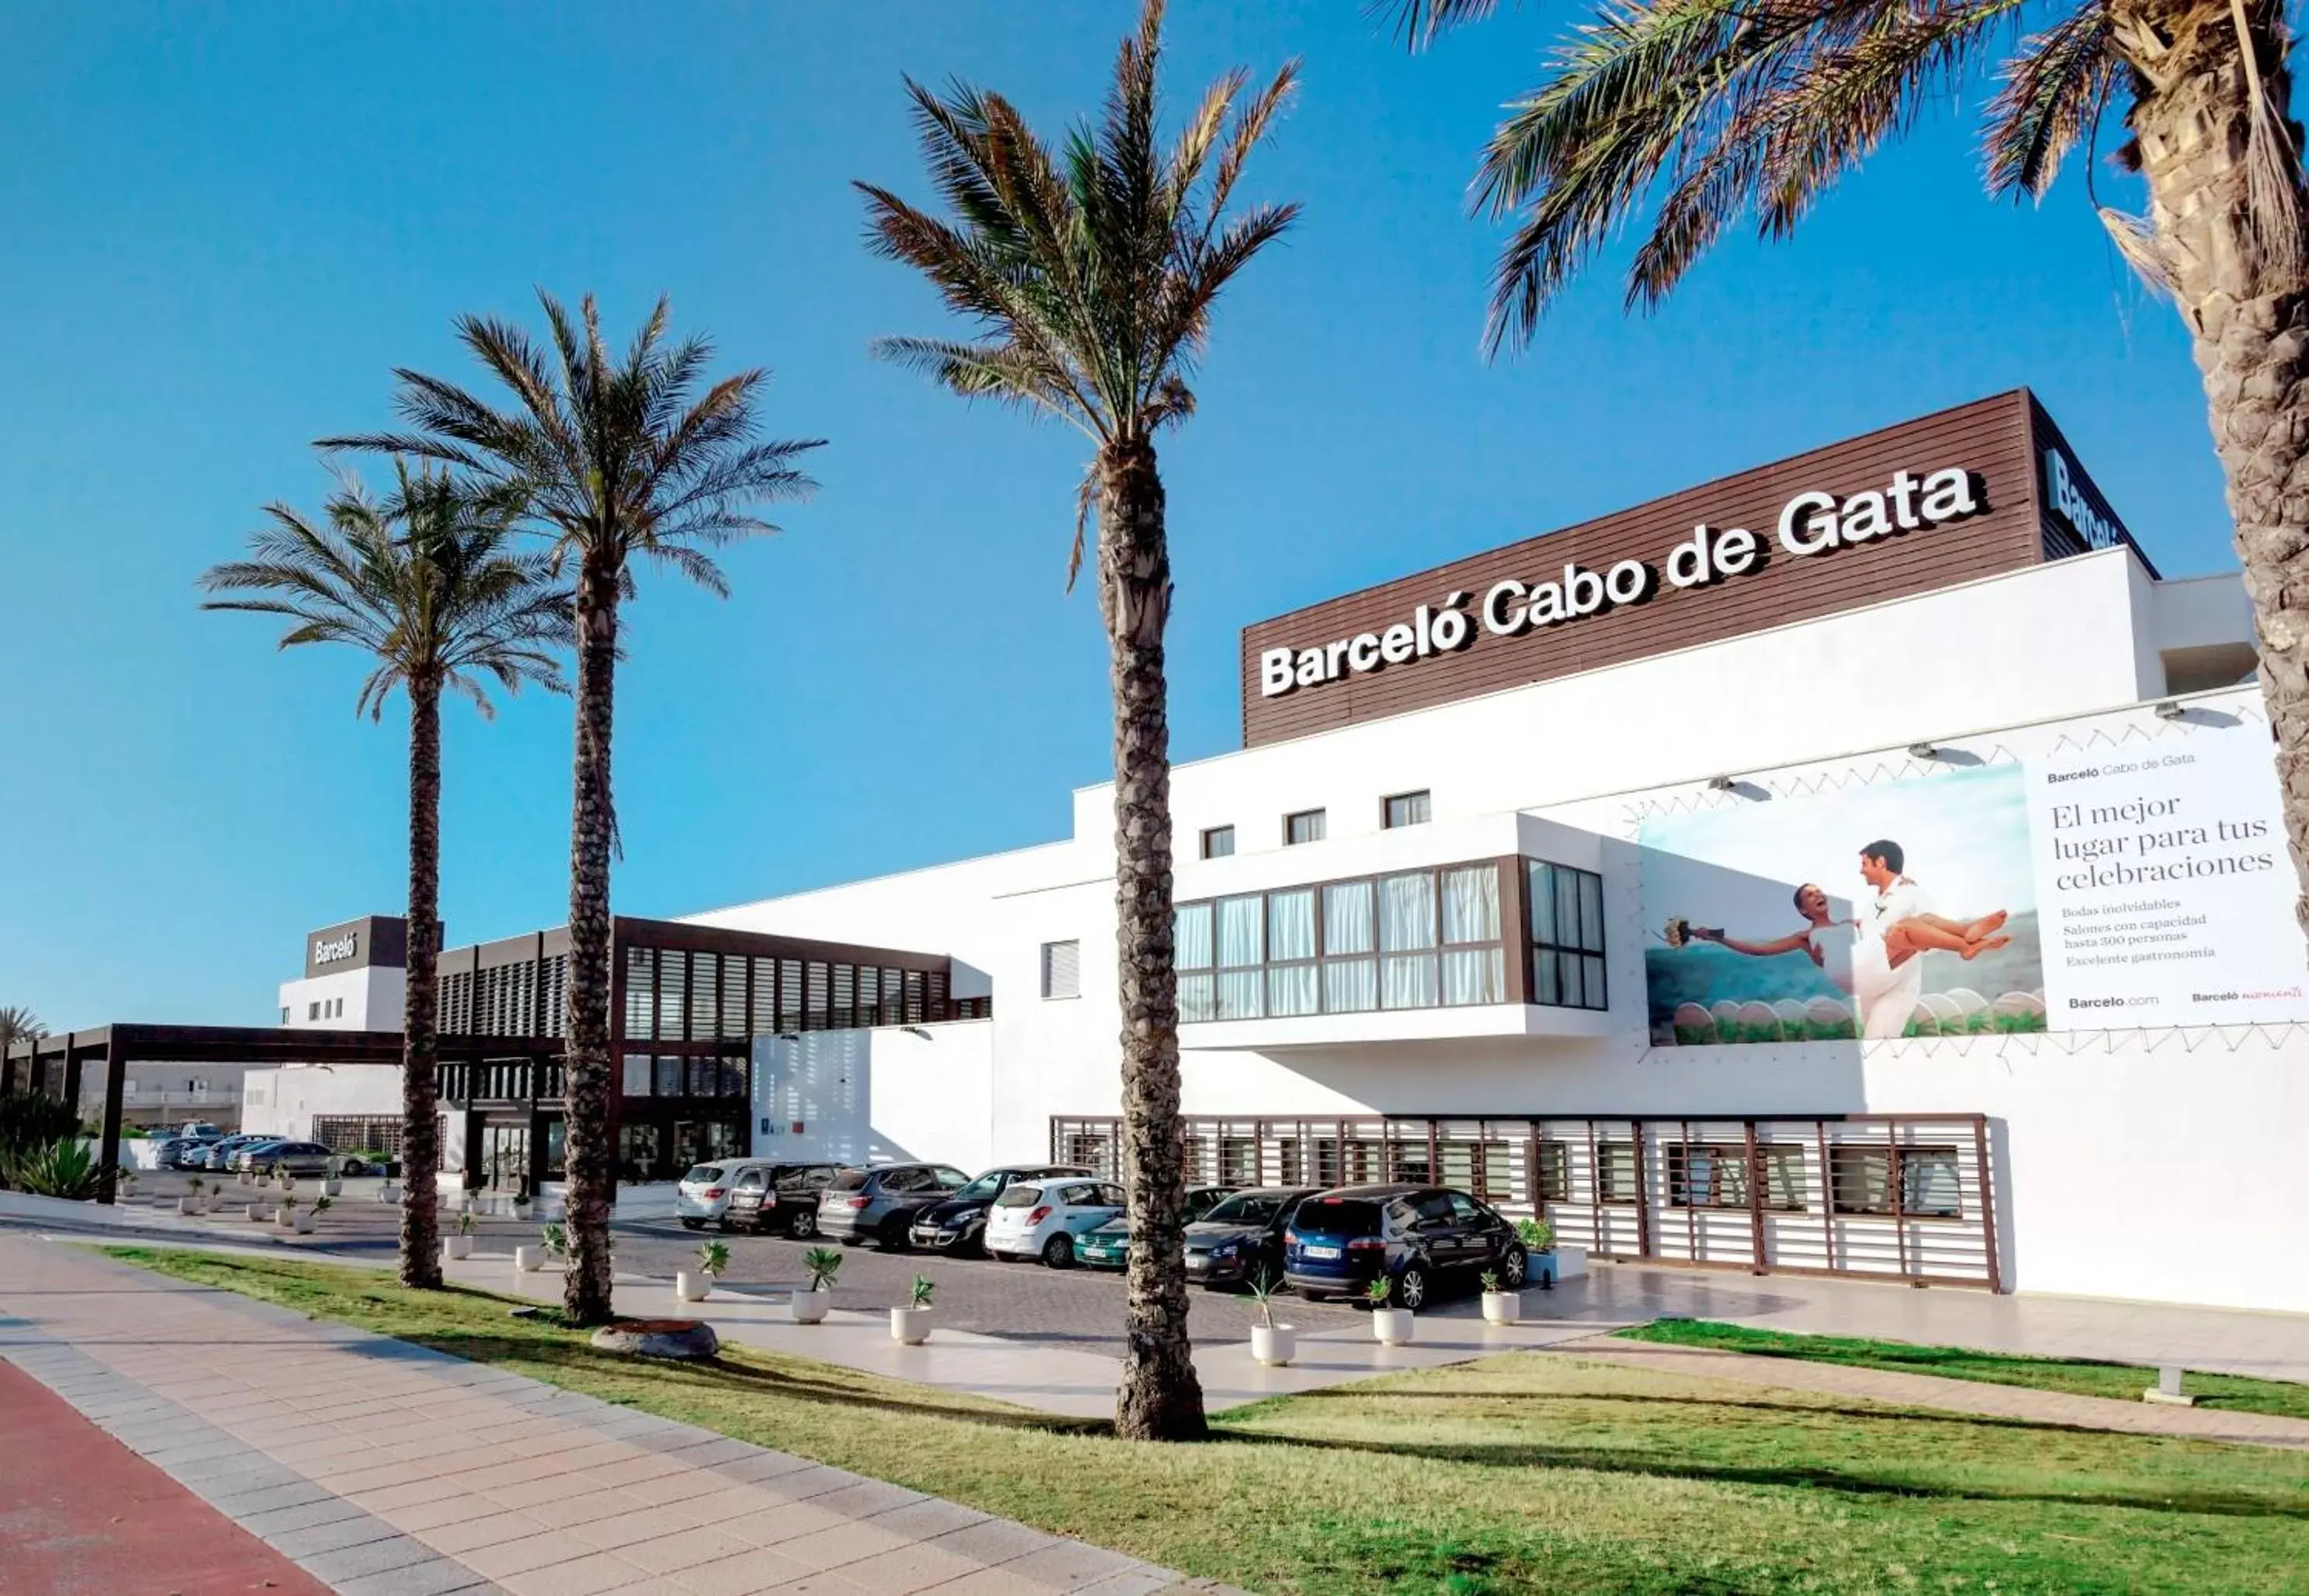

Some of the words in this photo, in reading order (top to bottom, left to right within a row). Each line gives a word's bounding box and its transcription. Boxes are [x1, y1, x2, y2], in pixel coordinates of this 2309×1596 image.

[1261, 589, 1467, 697] Barceló
[1483, 559, 1647, 635] Cabo
[1666, 523, 1756, 587] de
[1778, 468, 1977, 554] Gata
[2047, 768, 2099, 784] Barceló
[2103, 764, 2138, 776] Cabo
[2142, 759, 2159, 770] de
[2162, 754, 2196, 767] Gata
[2052, 803, 2081, 829] El
[2091, 796, 2180, 825] mejor
[2054, 837, 2129, 863] lugar
[2137, 829, 2207, 857] para
[2218, 819, 2268, 842] tus
[2056, 851, 2273, 891] celebraciones
[2062, 905, 2099, 918] Bodas
[2102, 898, 2181, 915] inolvidables
[2063, 922, 2111, 936] Salones
[2114, 922, 2138, 932] con
[2140, 914, 2207, 931] capacidad
[314, 932, 355, 964] Barceló
[2064, 938, 2098, 949] hasta
[2100, 935, 2125, 946] 300
[2128, 932, 2188, 946] personas
[2067, 953, 2129, 968] Excelente
[2131, 946, 2216, 965] gastronomía
[2069, 995, 2160, 1010] Barcelo.com
